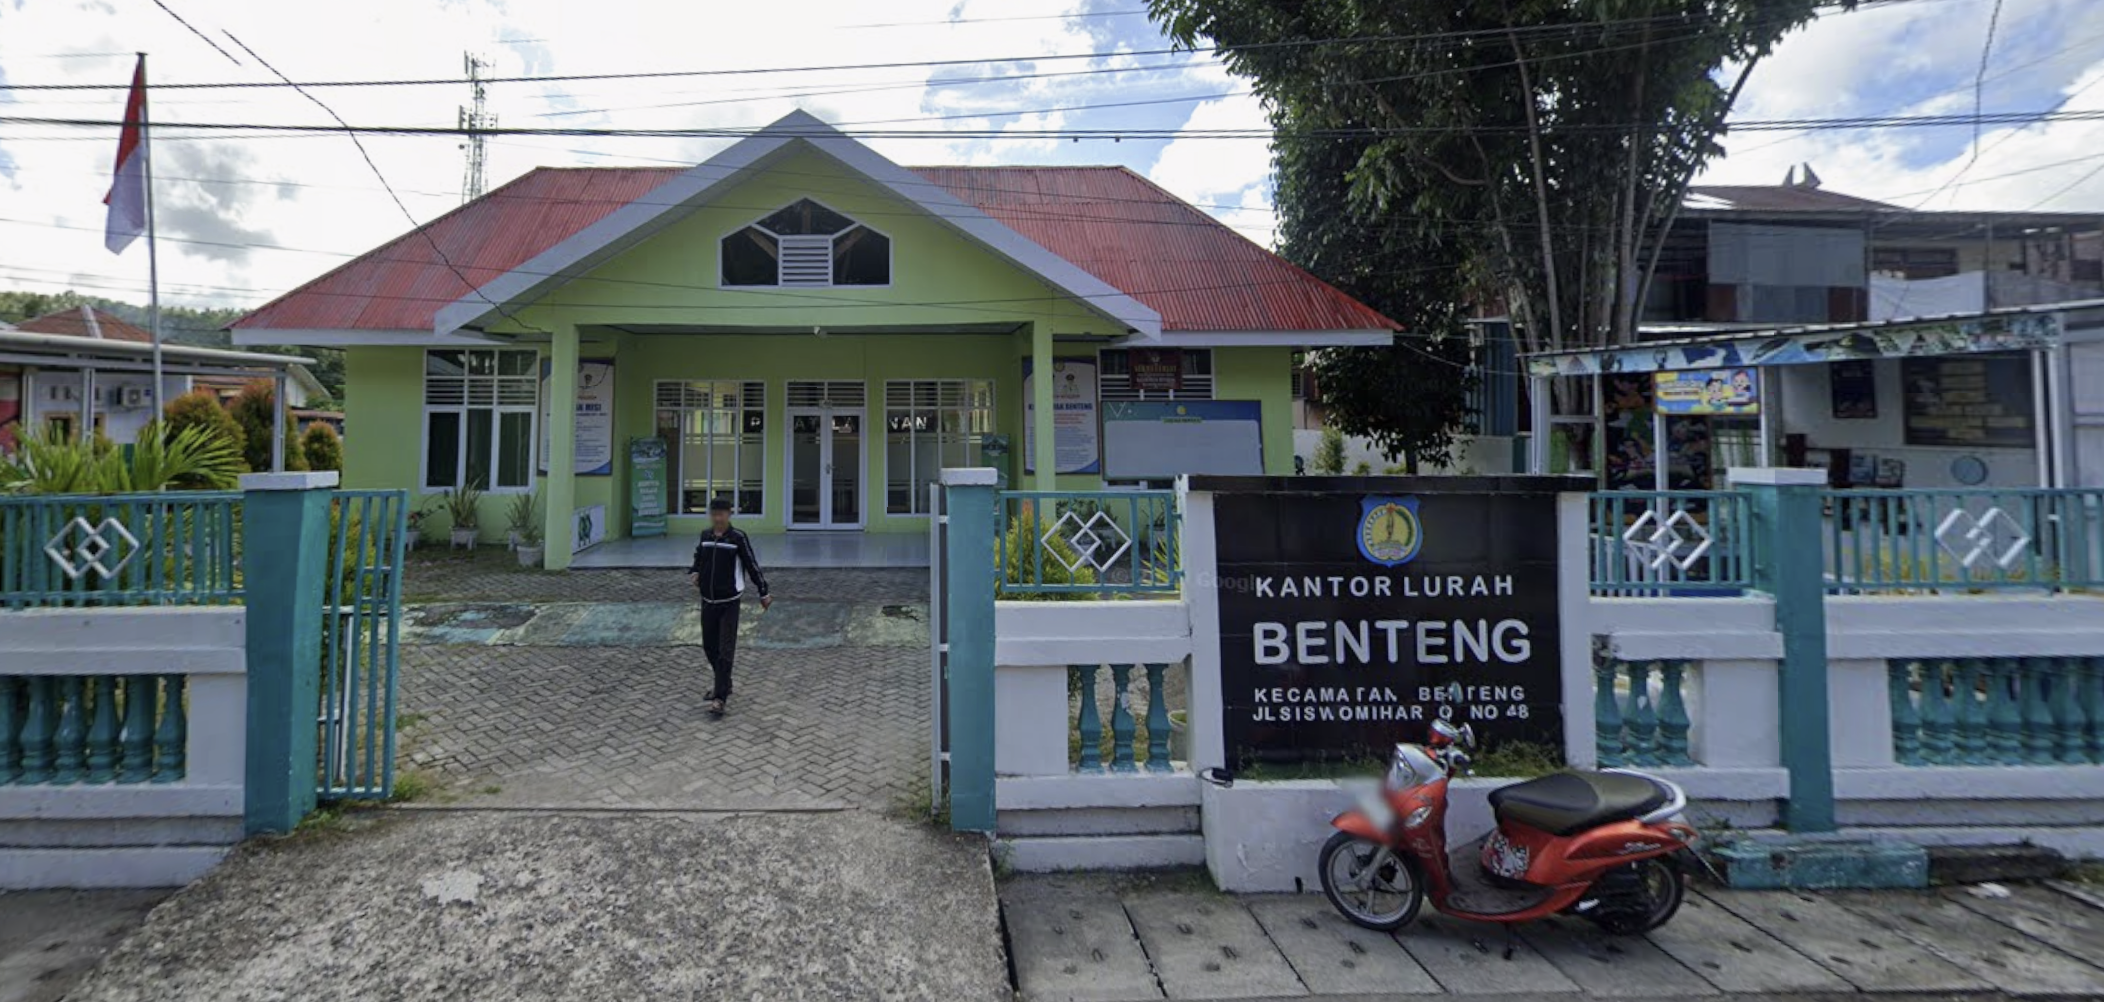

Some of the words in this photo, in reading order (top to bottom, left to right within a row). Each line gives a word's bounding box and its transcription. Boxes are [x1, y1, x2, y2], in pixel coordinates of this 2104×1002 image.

[1255, 576, 1392, 598] KANTOR
[1403, 575, 1513, 597] LURAH
[1253, 618, 1531, 665] BENTENG
[1470, 704, 1499, 720] NO
[1506, 703, 1529, 719] 48
